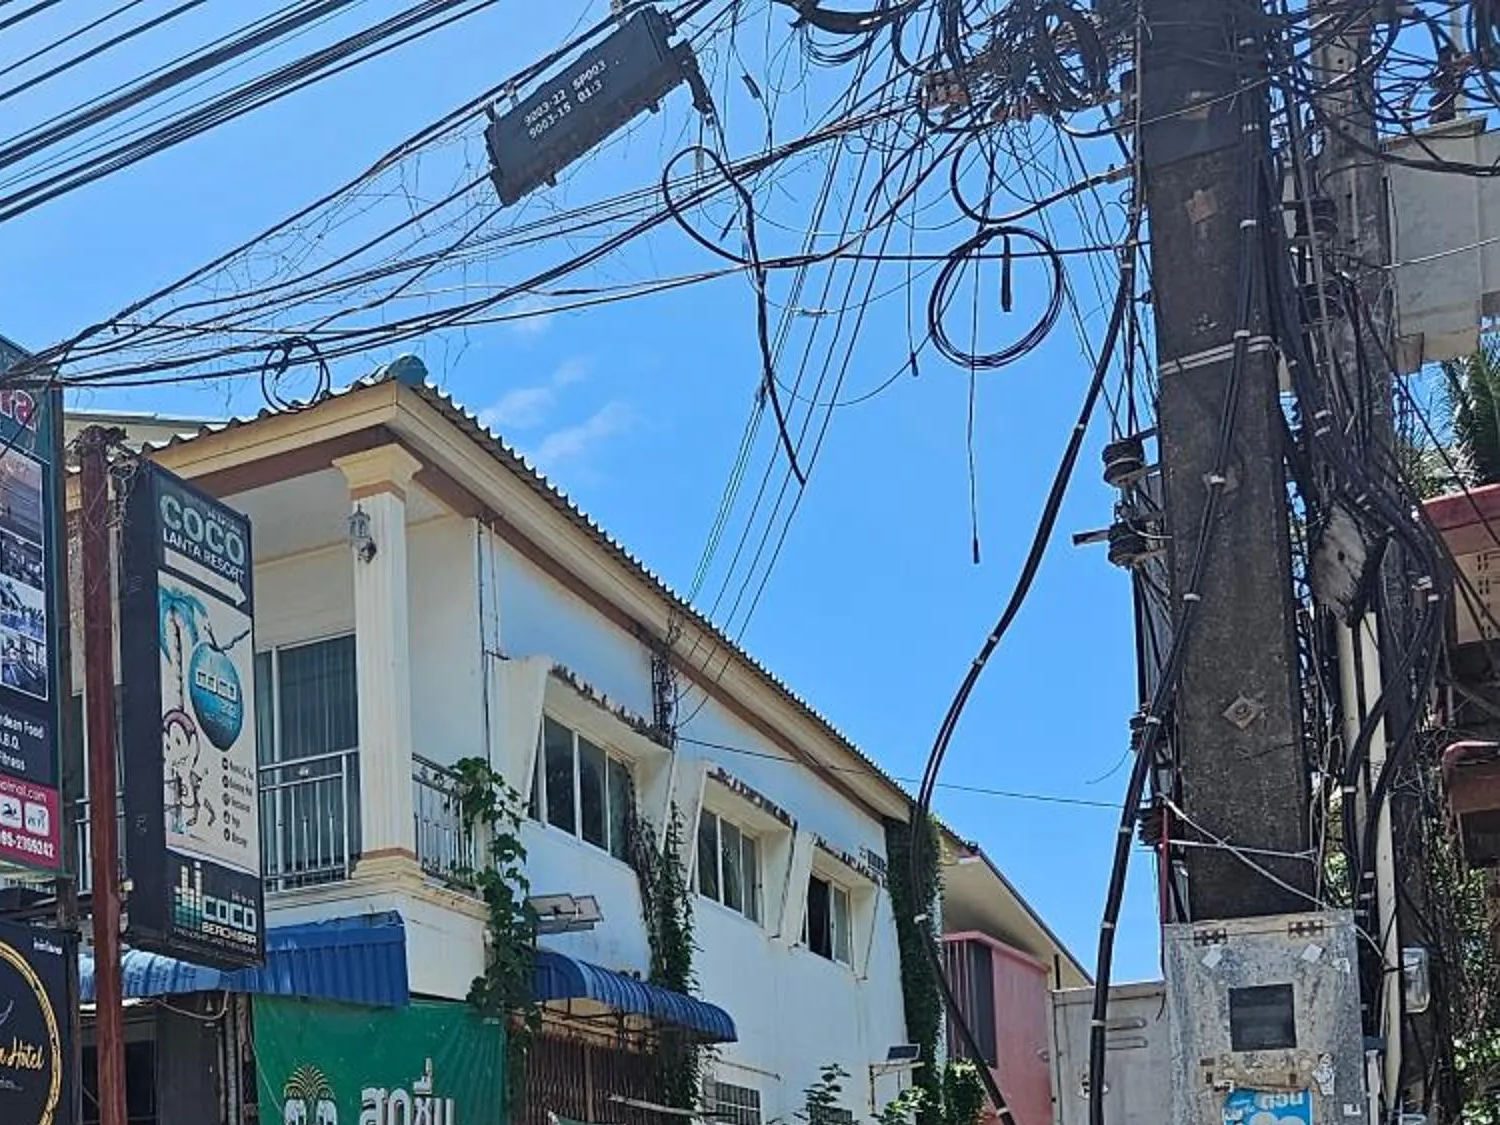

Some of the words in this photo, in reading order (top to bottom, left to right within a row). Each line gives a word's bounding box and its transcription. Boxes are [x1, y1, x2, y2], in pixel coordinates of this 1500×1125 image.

[159, 494, 245, 566] COCO
[163, 527, 203, 559] LANTA
[203, 550, 245, 584] RESORT
[23, 721, 45, 740] Food
[202, 893, 257, 934] COCO
[6, 1036, 45, 1071] Hotel
